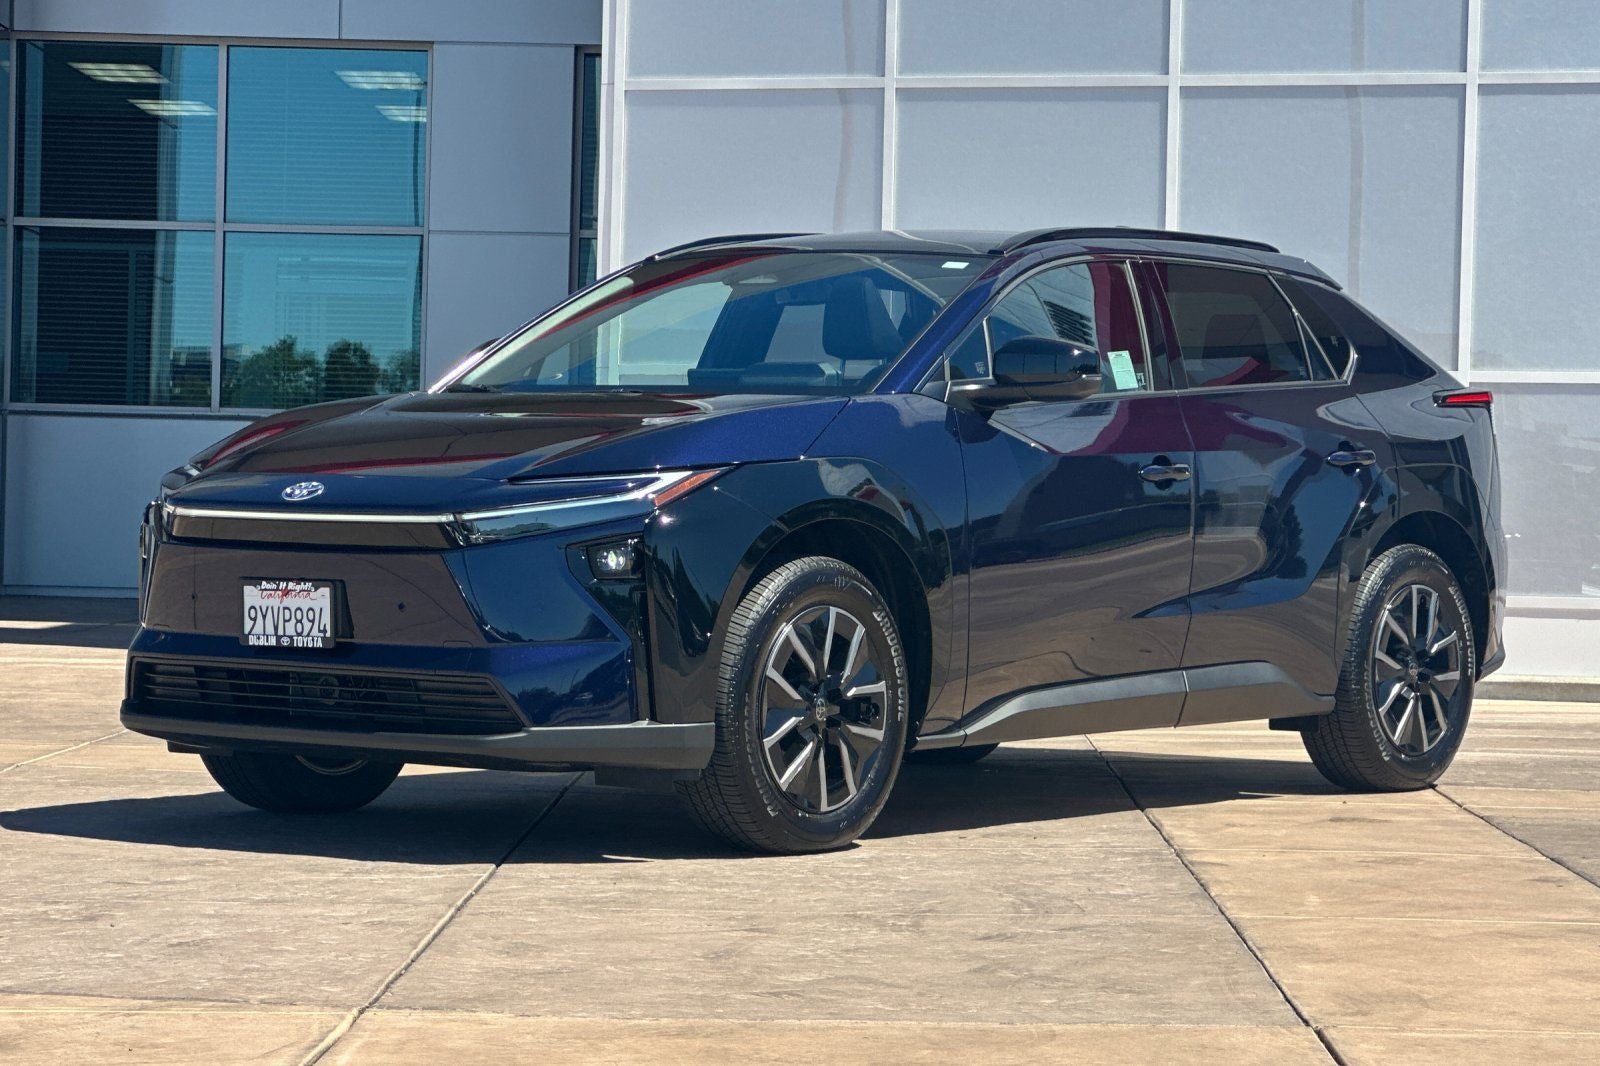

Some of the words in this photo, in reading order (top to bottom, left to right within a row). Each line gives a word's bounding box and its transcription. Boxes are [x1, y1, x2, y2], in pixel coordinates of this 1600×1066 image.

[279, 582, 287, 590] It
[247, 605, 328, 637] 9YVP894
[248, 635, 277, 646] DUBLIN
[293, 636, 323, 648] TOYOTA
[872, 605, 905, 722] BRIDGESTONE
